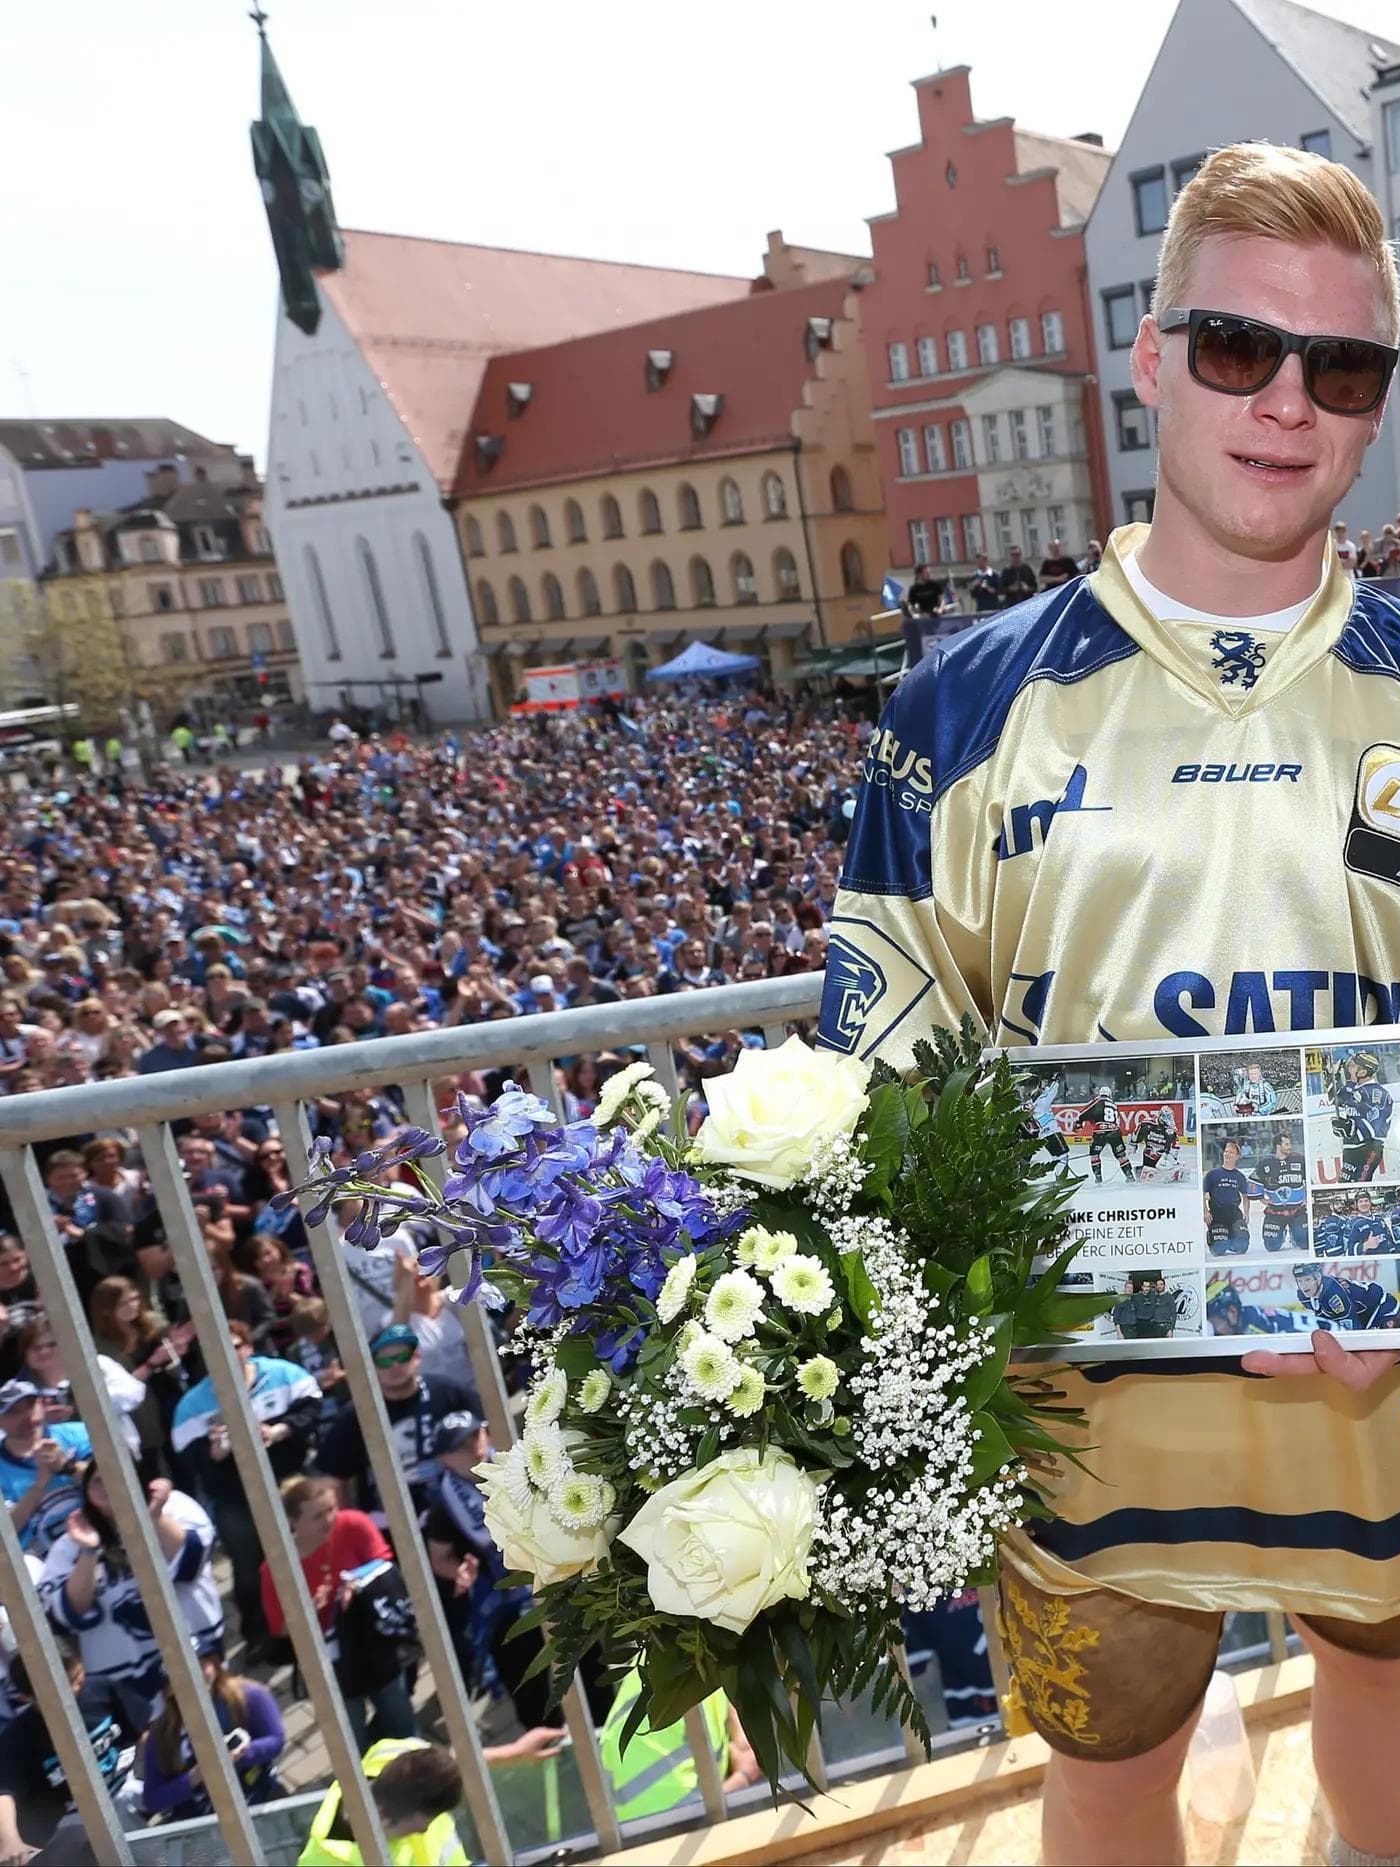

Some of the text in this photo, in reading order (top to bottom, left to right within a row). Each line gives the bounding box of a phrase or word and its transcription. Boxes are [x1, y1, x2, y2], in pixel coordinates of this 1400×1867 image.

[1047, 1207, 1176, 1225] NKE CHRISTOPH
[1075, 1227, 1113, 1240] DEINE
[1117, 1226, 1144, 1239] ZEIT
[1082, 1245, 1107, 1258] ERC
[1110, 1241, 1194, 1257] INGOLSTADT
